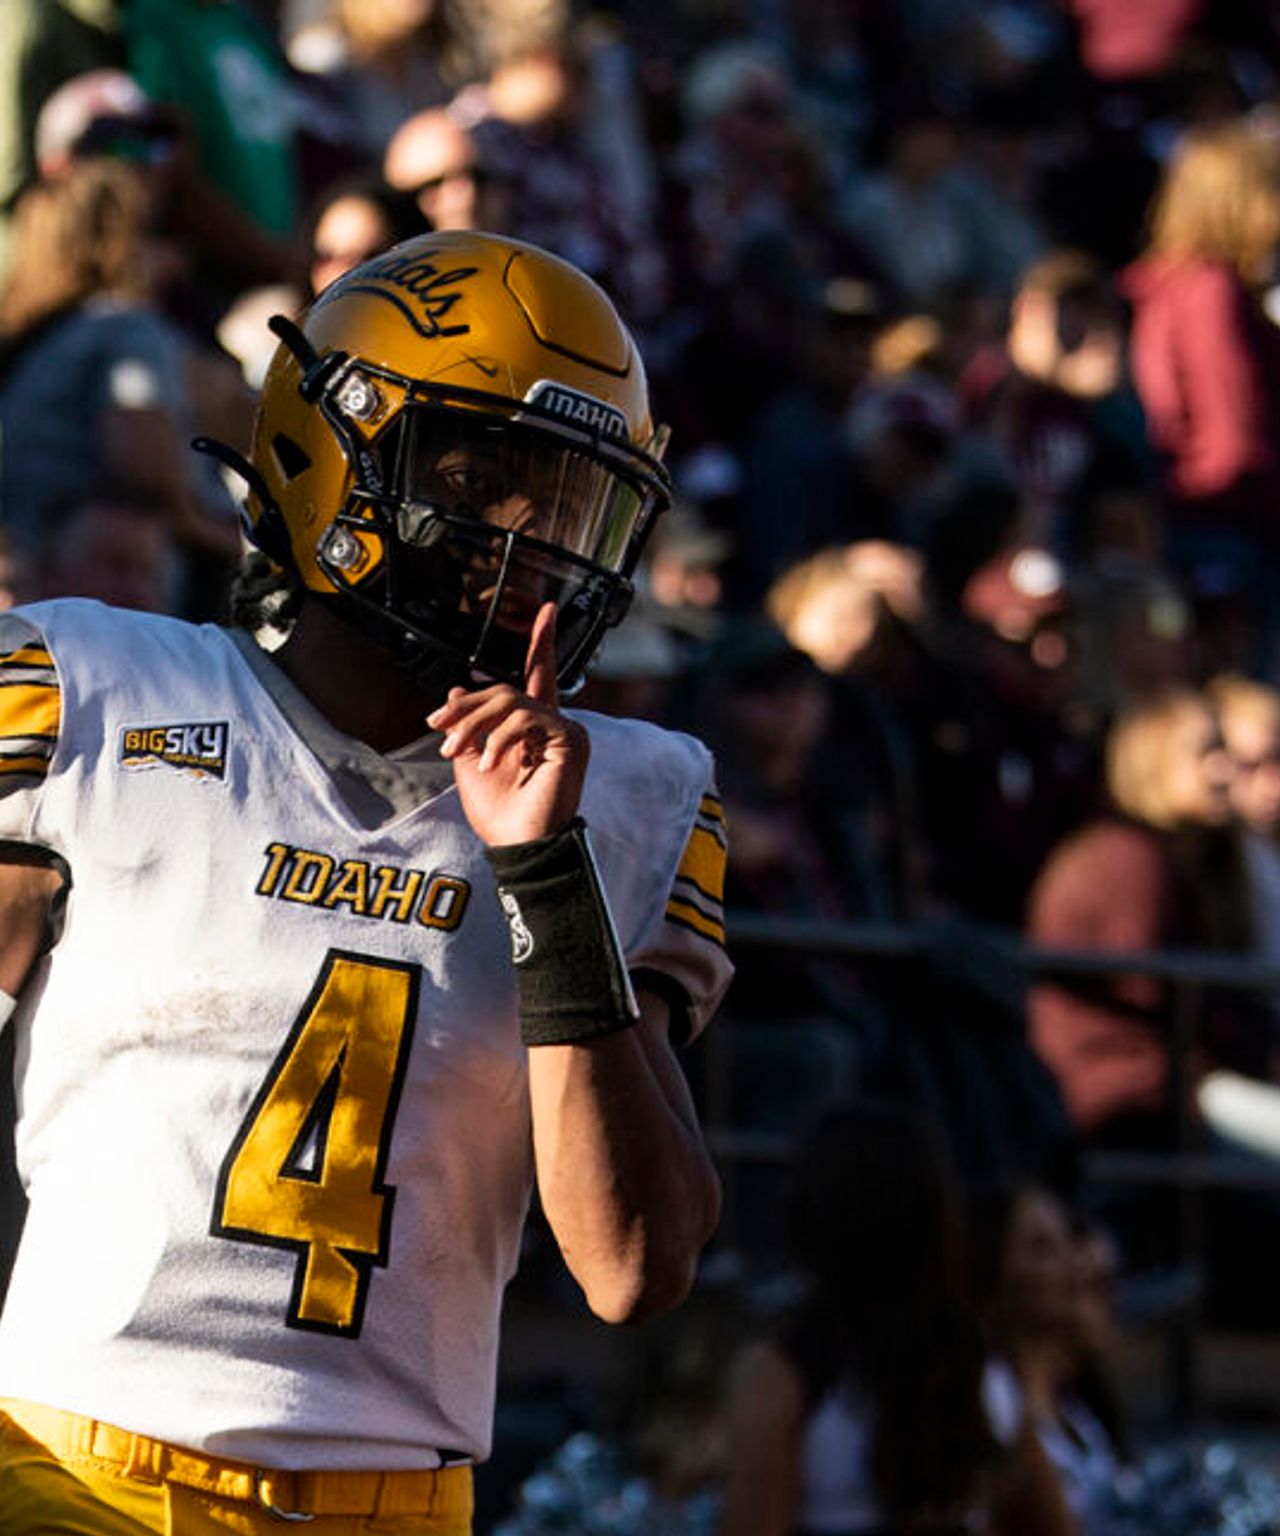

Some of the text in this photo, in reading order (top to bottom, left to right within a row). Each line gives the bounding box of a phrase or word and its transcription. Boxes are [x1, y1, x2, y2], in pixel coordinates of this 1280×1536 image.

[543, 390, 625, 438] IDAHO
[255, 842, 472, 932] IDAHO
[209, 947, 422, 1340] 4
